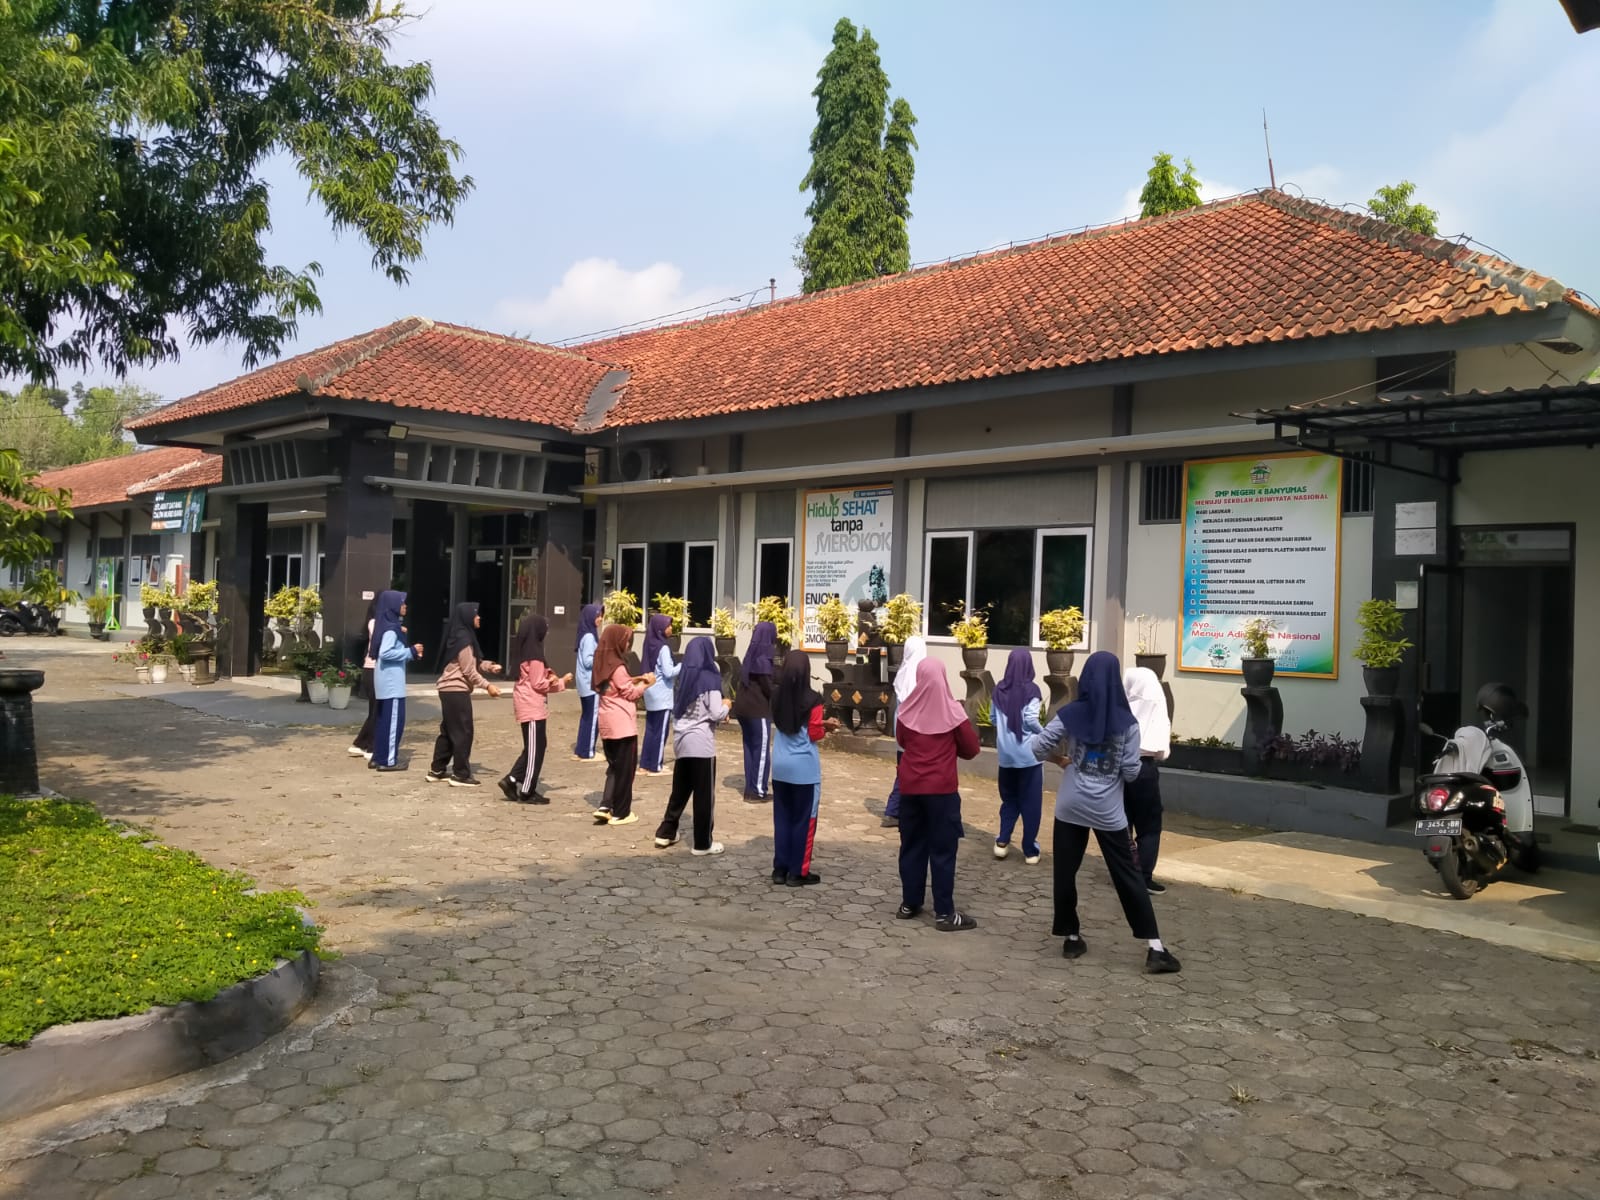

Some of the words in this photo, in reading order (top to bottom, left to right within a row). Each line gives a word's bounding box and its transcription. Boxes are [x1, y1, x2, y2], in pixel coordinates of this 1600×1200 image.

[808, 502, 839, 519] Hidup
[842, 500, 879, 516] SEHAT
[831, 519, 863, 535] tanpa
[816, 532, 891, 553] MEROKOK
[1192, 630, 1224, 639] Menuju
[1278, 632, 1320, 640] Nasional
